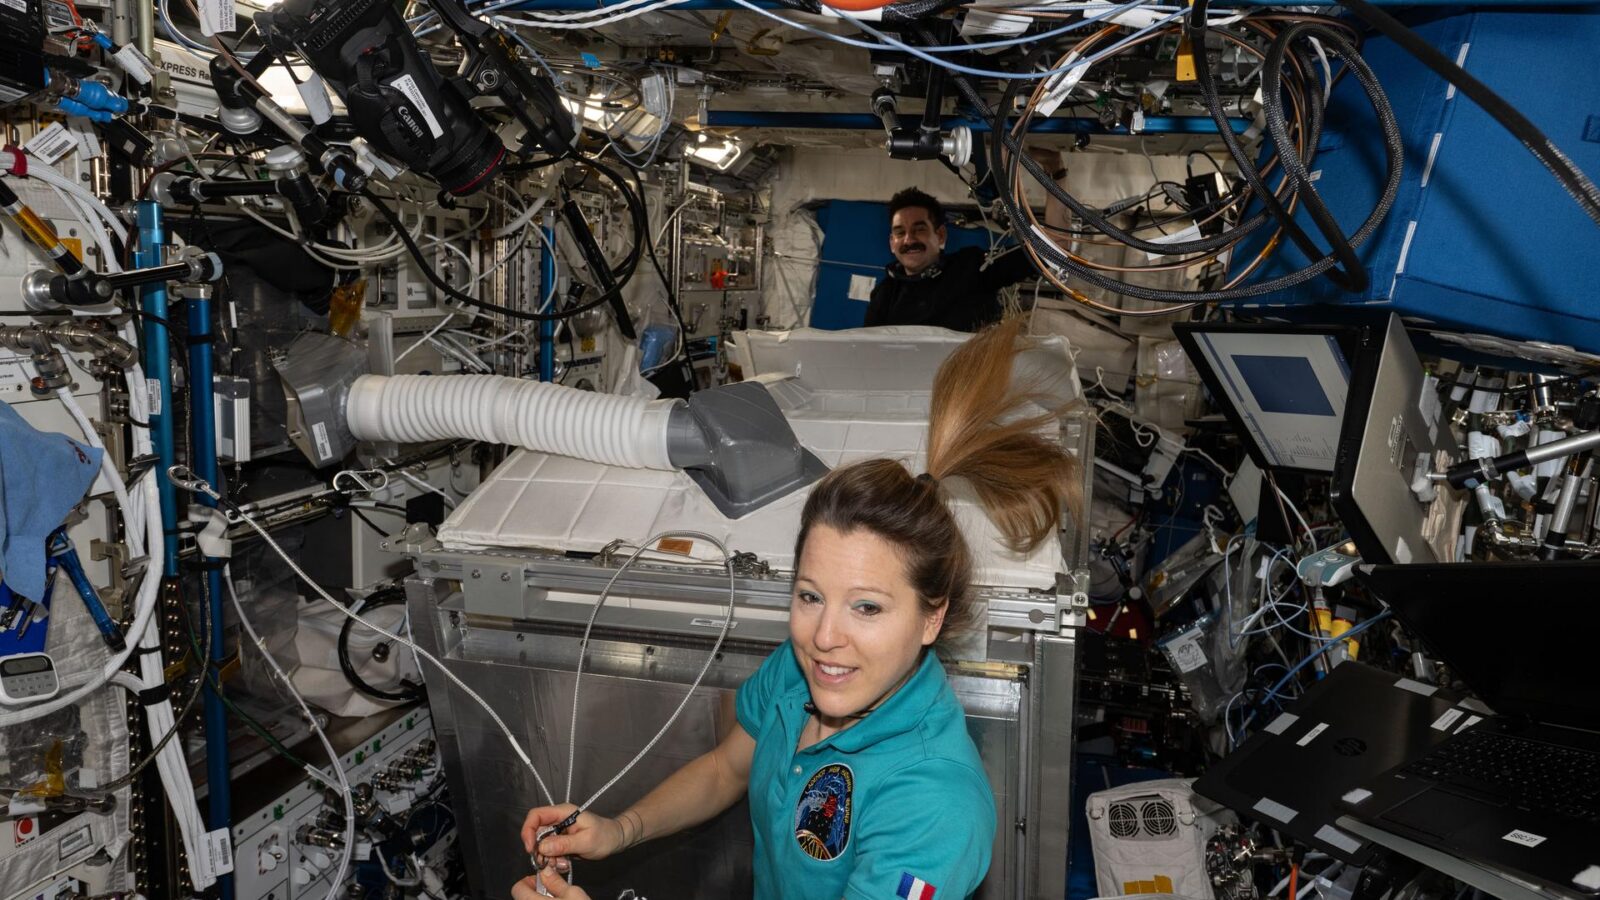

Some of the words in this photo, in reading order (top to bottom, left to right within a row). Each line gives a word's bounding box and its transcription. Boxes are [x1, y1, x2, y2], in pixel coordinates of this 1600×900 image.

[159, 60, 197, 77] XPRESS
[199, 70, 212, 80] Ra
[398, 106, 424, 138] Canon
